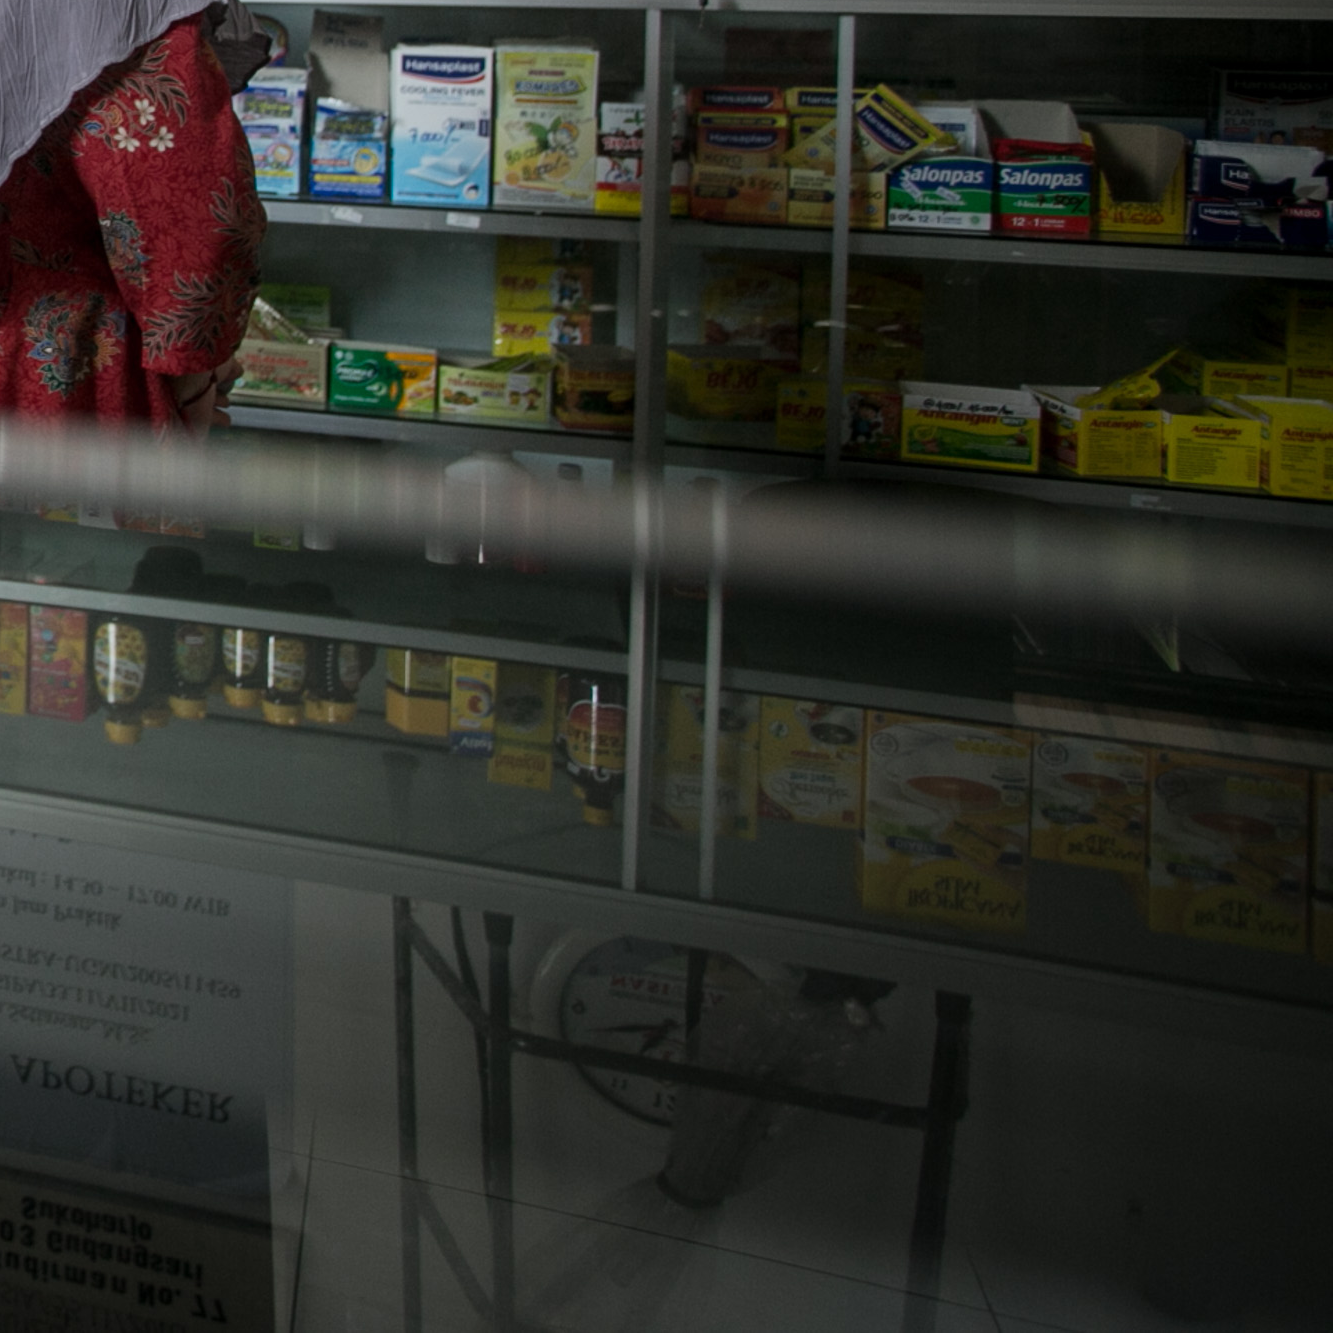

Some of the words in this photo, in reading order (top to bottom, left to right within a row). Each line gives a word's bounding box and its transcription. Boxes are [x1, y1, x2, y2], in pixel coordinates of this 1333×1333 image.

[404, 54, 483, 75] Hansaplast
[450, 84, 486, 98] FEVER
[860, 106, 919, 150] Hansaplast
[707, 131, 773, 147] Hansaplast
[899, 160, 984, 187] Salonpas
[997, 165, 1085, 190] Salonpas
[915, 214, 929, 225] 12
[1010, 215, 1025, 228] 12
[705, 369, 759, 390] BEJO
[1210, 369, 1267, 382] Antangin
[780, 401, 825, 420] BEJO
[1089, 418, 1145, 430] Antangin
[1191, 425, 1243, 436] Antangin
